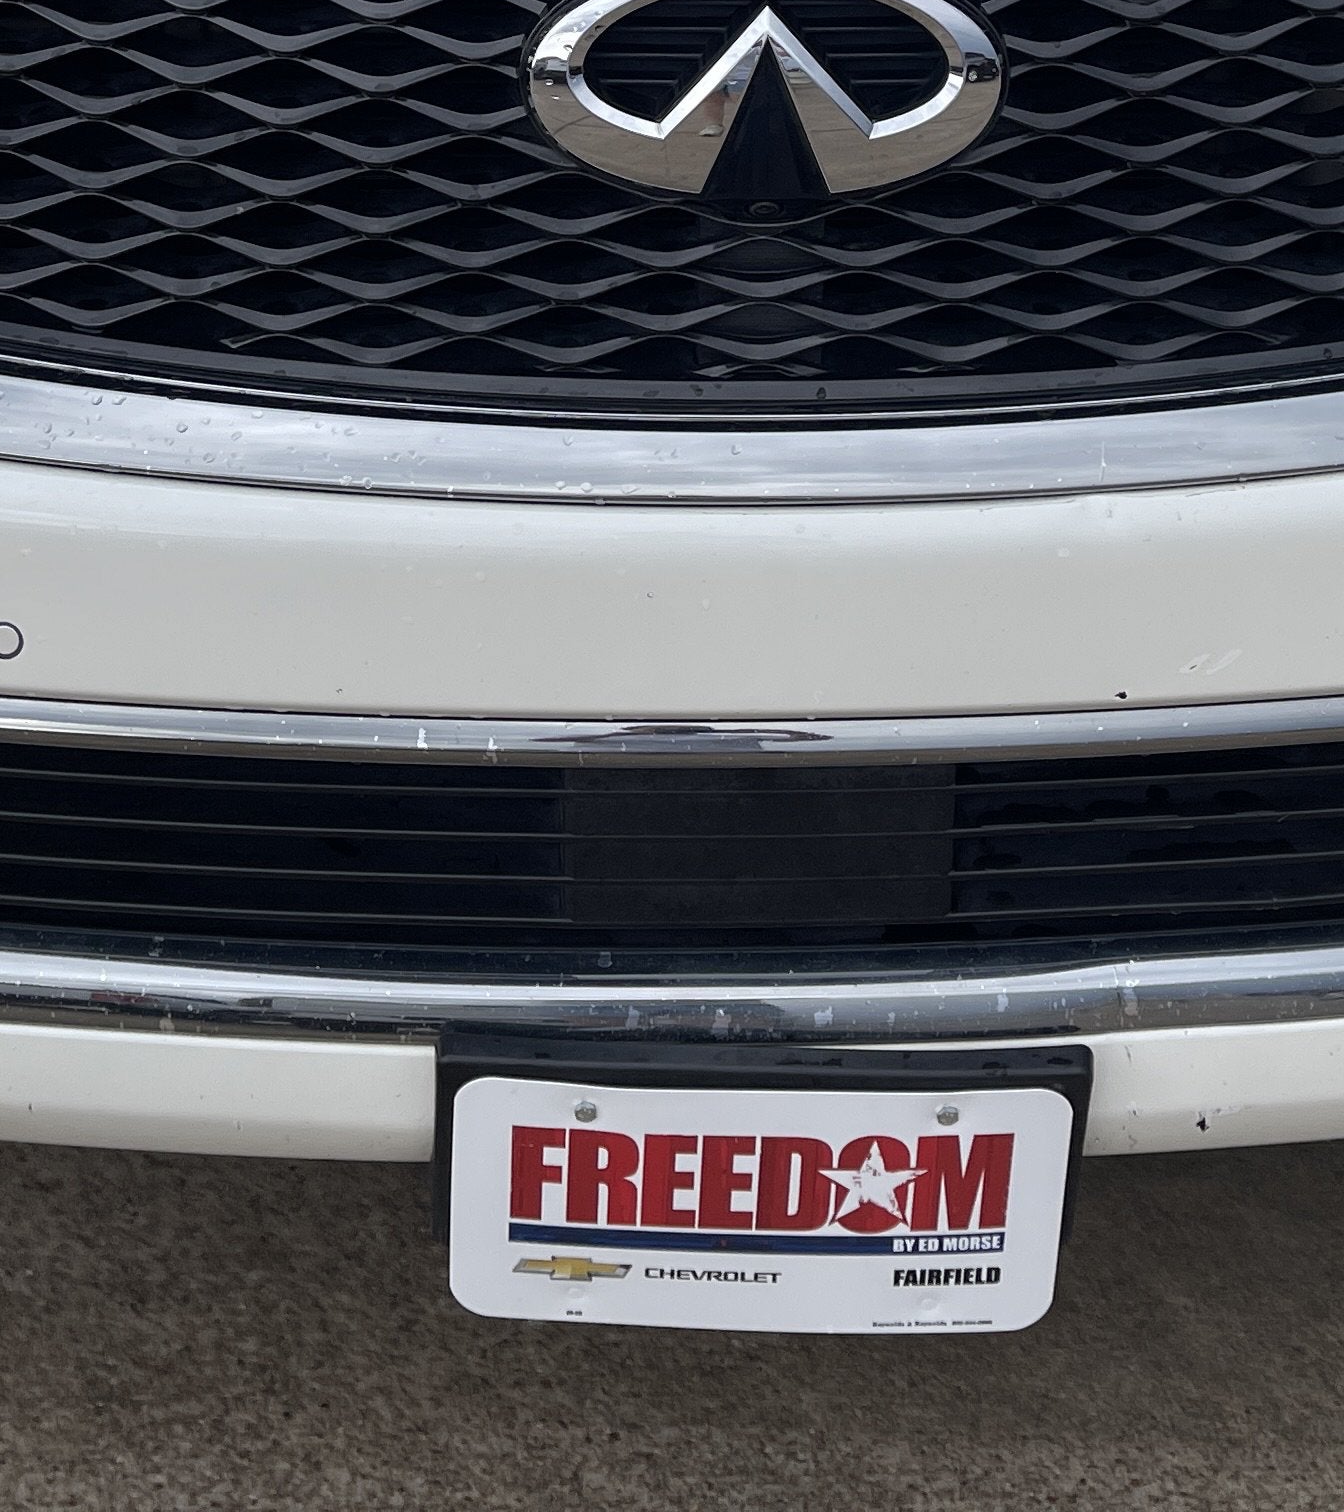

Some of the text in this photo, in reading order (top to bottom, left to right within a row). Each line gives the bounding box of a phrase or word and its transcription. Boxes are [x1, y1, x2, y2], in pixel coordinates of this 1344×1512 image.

[510, 1125, 1015, 1235] FREEDOM
[892, 1235, 1001, 1253] BY ED MORSE
[644, 1267, 782, 1284] CHEVROLET
[893, 1267, 1001, 1287] FAIRFIELD
